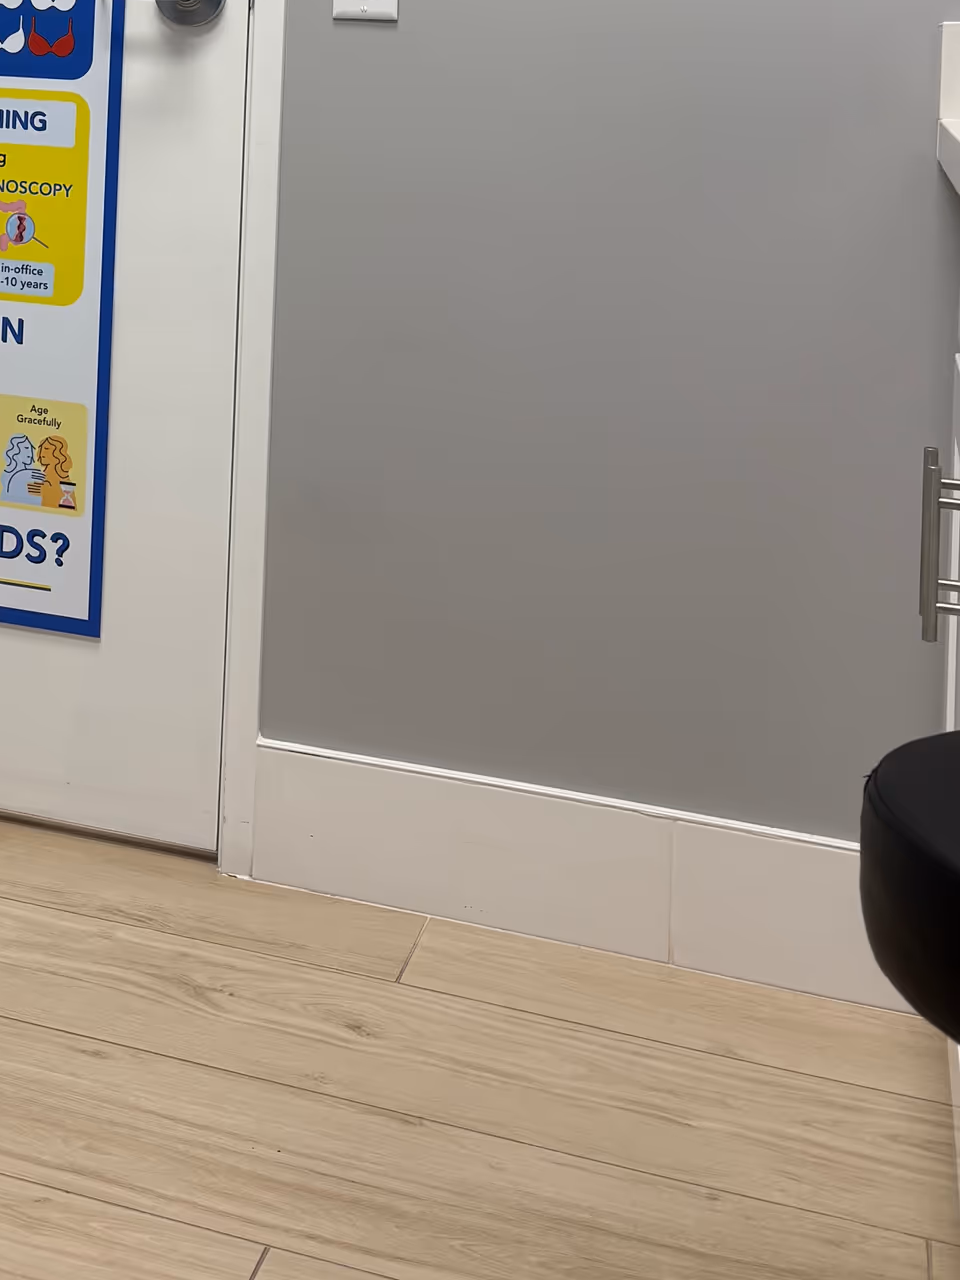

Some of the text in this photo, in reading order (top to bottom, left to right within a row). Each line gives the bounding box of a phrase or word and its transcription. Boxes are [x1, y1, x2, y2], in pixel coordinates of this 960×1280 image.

[1, 263, 44, 277] in-office
[20, 278, 48, 292] years
[30, 405, 49, 417] Age
[16, 413, 62, 429] Gracefully
